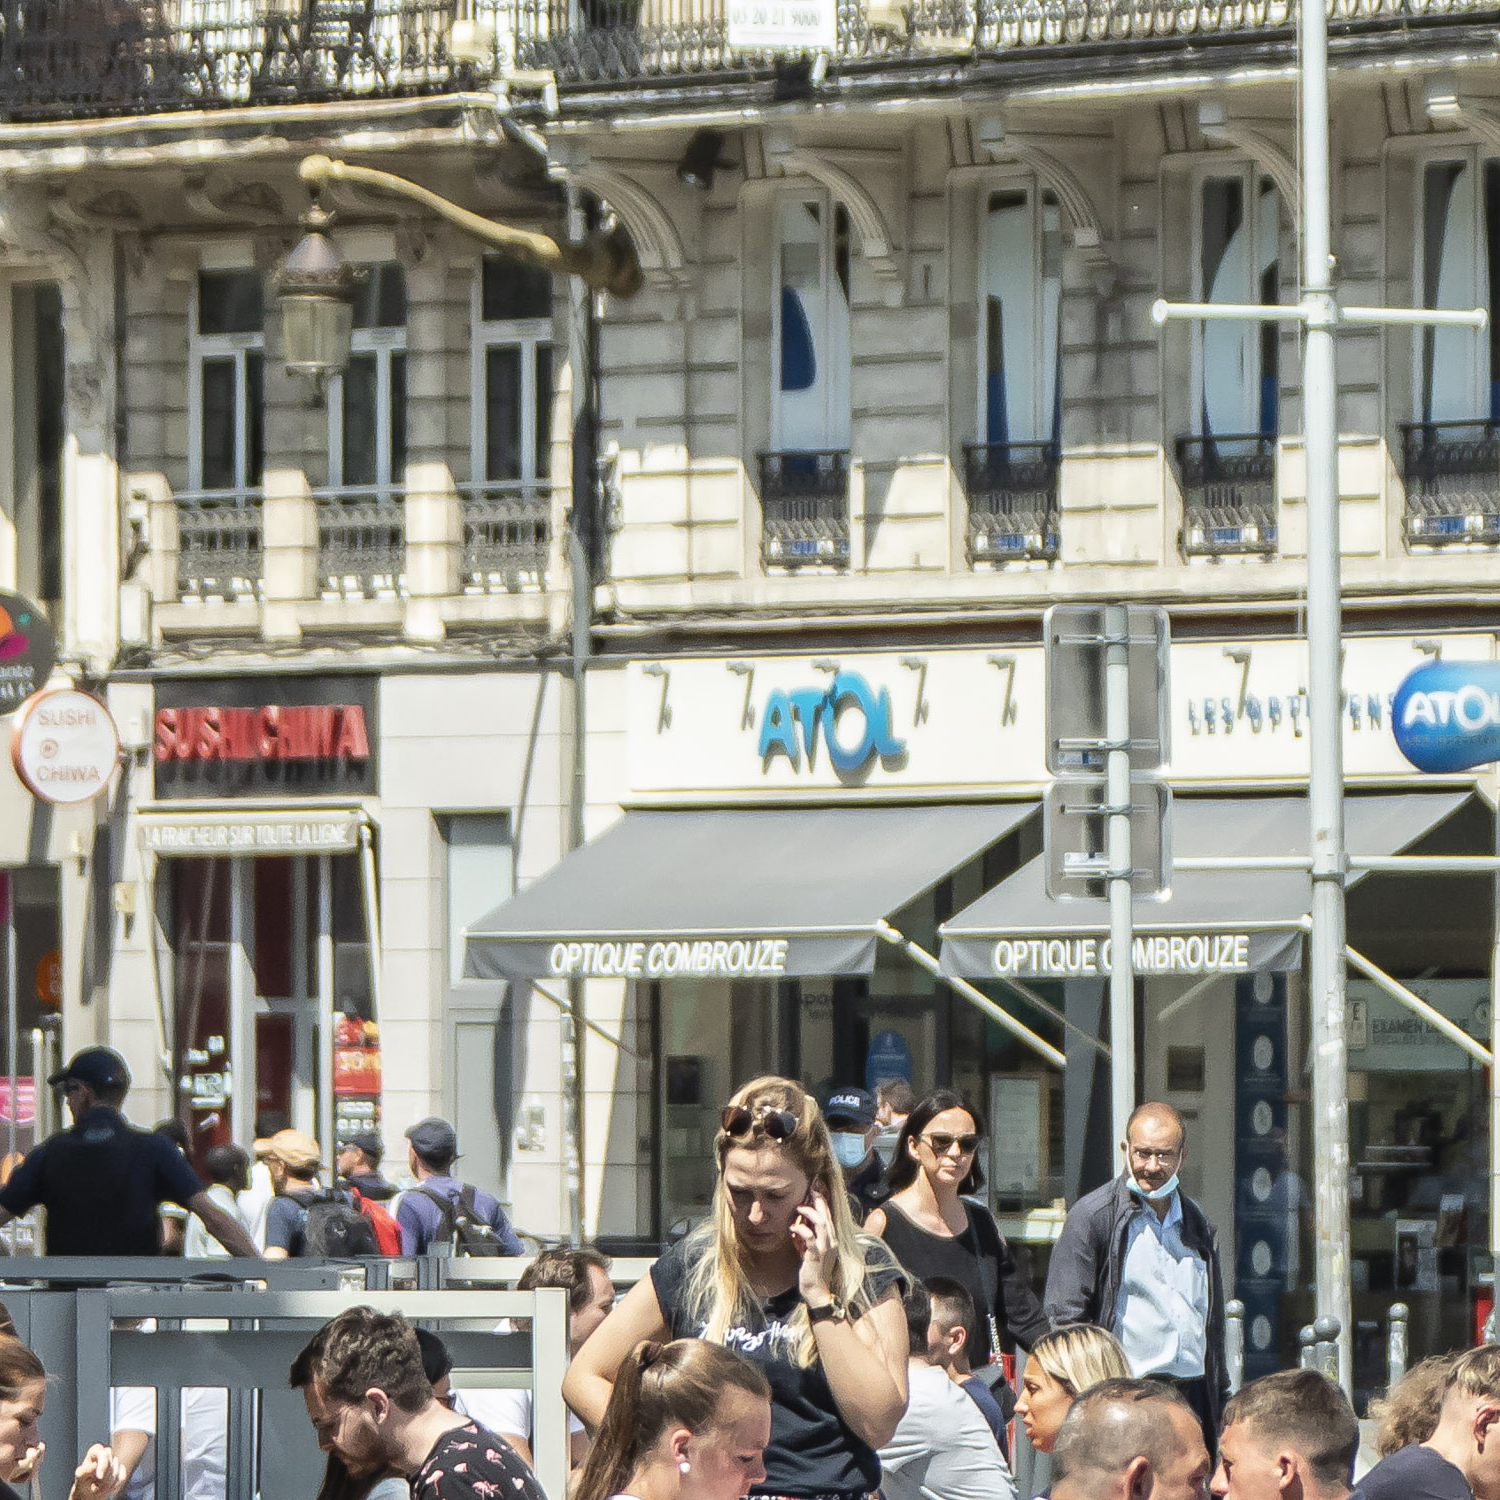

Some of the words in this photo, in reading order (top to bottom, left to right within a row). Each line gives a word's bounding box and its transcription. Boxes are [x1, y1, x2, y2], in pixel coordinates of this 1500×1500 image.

[38, 709, 96, 726] SUSHI
[758, 670, 907, 772] ATOL
[36, 766, 100, 782] CHIWA
[550, 942, 646, 973] OPTIQUE
[648, 939, 788, 972] COMBROUZE
[994, 938, 1098, 972] OPTIQUE
[1102, 935, 1250, 970] CMBROUZE
[829, 1094, 860, 1108] POLICE
